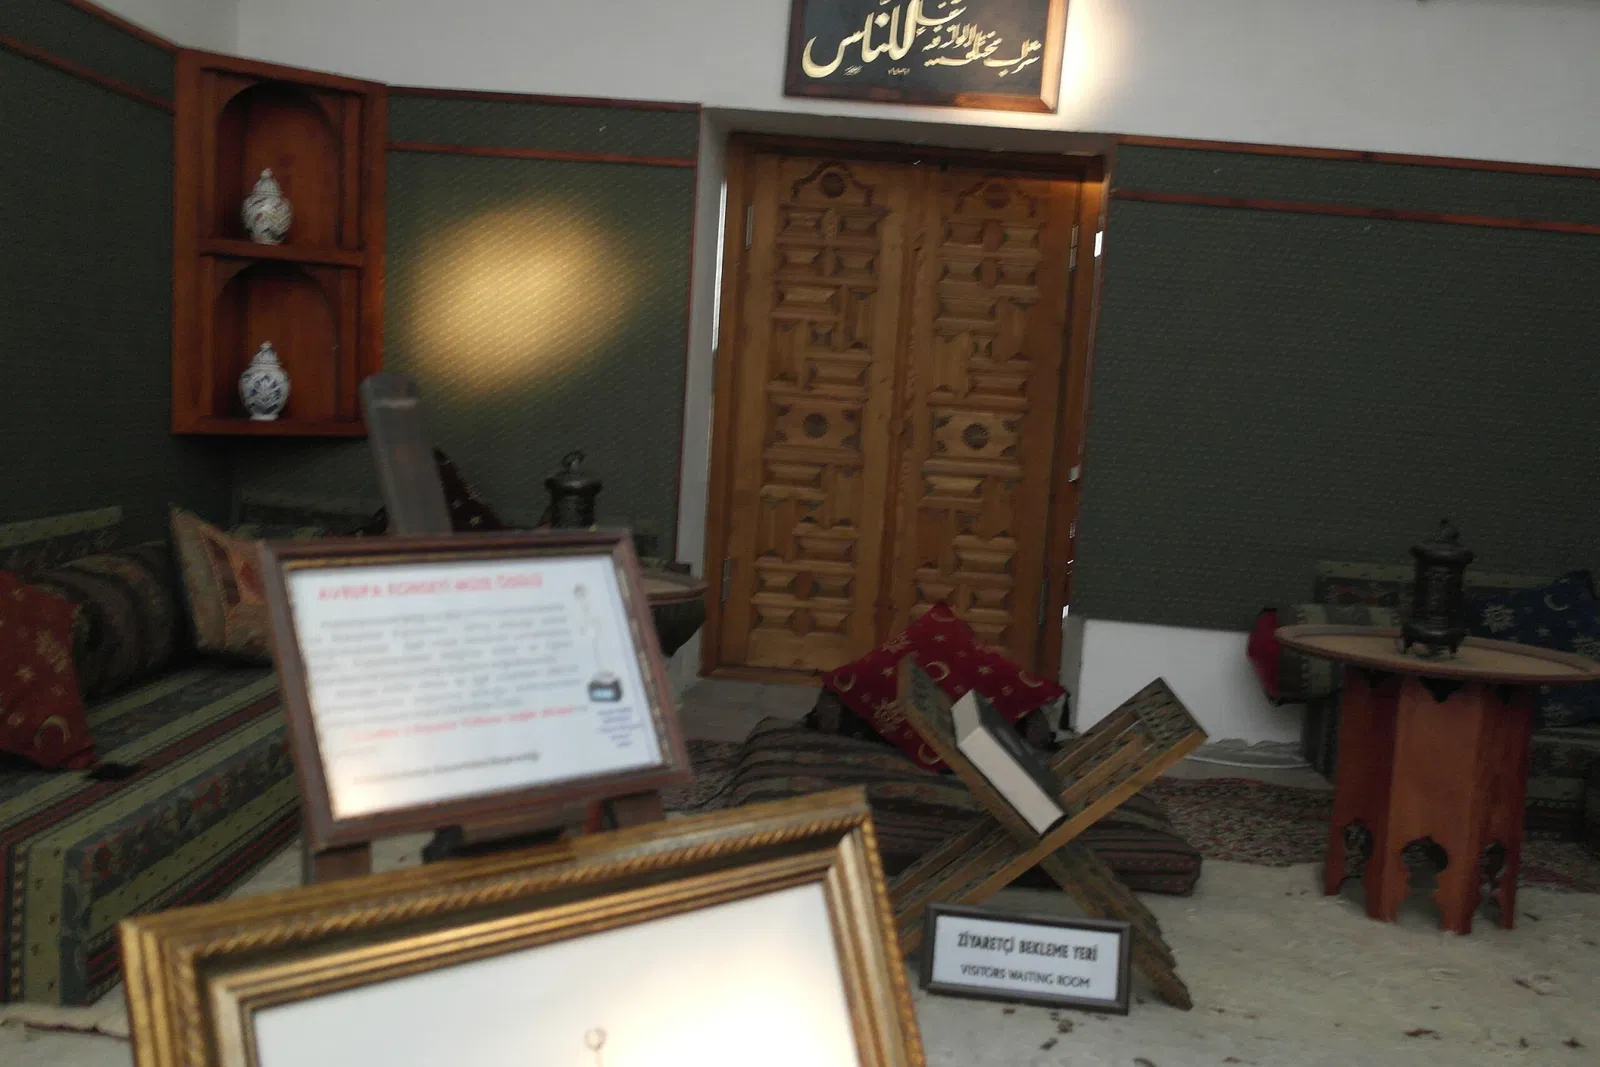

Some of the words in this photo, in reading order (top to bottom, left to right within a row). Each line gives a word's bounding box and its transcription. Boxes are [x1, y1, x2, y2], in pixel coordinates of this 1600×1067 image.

[957, 931, 1014, 955] ZİYARETÇİ
[1019, 940, 1069, 959] BEKLEME
[961, 964, 1005, 979] VISITORS
[1008, 968, 1053, 985] WAITING
[1057, 975, 1091, 988] ROOM
